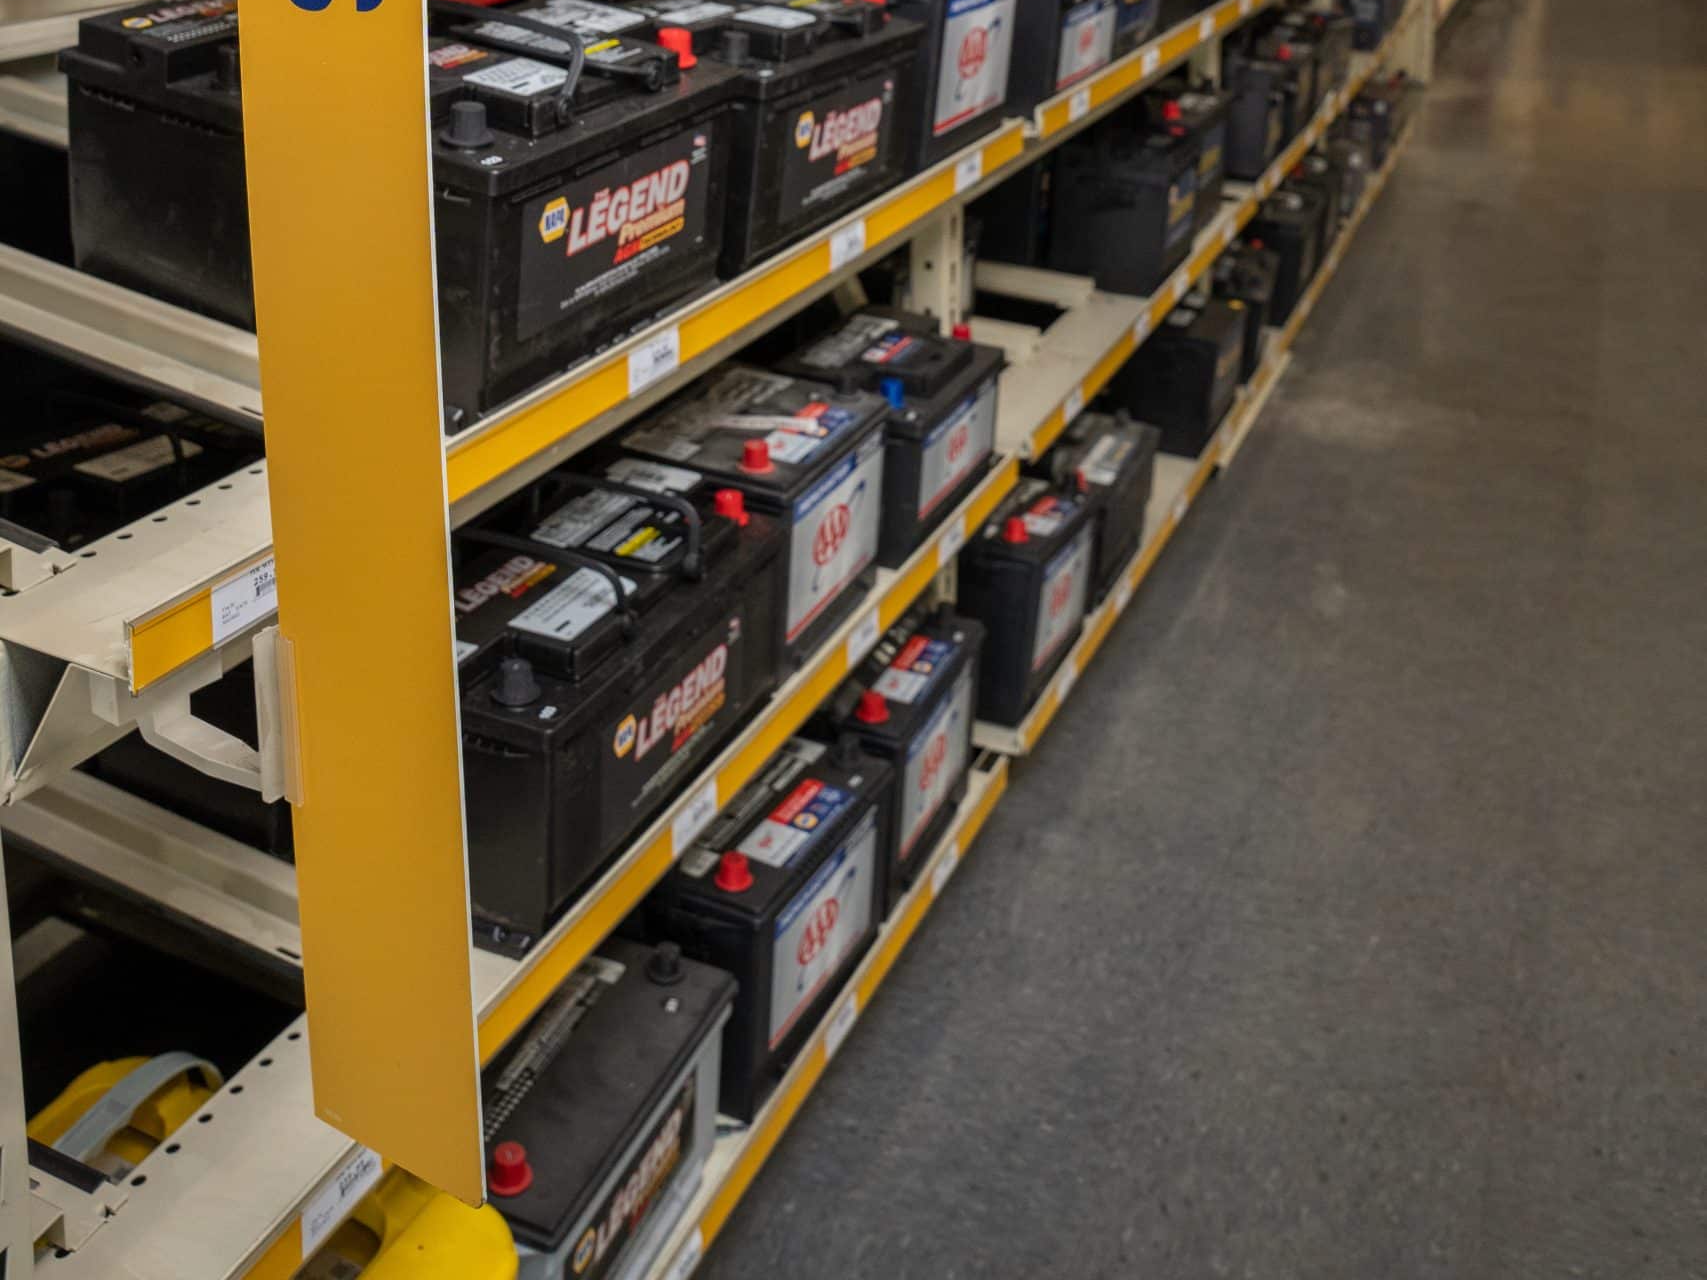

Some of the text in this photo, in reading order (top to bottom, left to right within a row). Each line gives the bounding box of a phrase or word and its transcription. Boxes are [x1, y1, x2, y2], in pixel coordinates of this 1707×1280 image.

[807, 97, 883, 163] LEGEND
[566, 159, 691, 257] LEGEND
[633, 643, 728, 763] LEGEND
